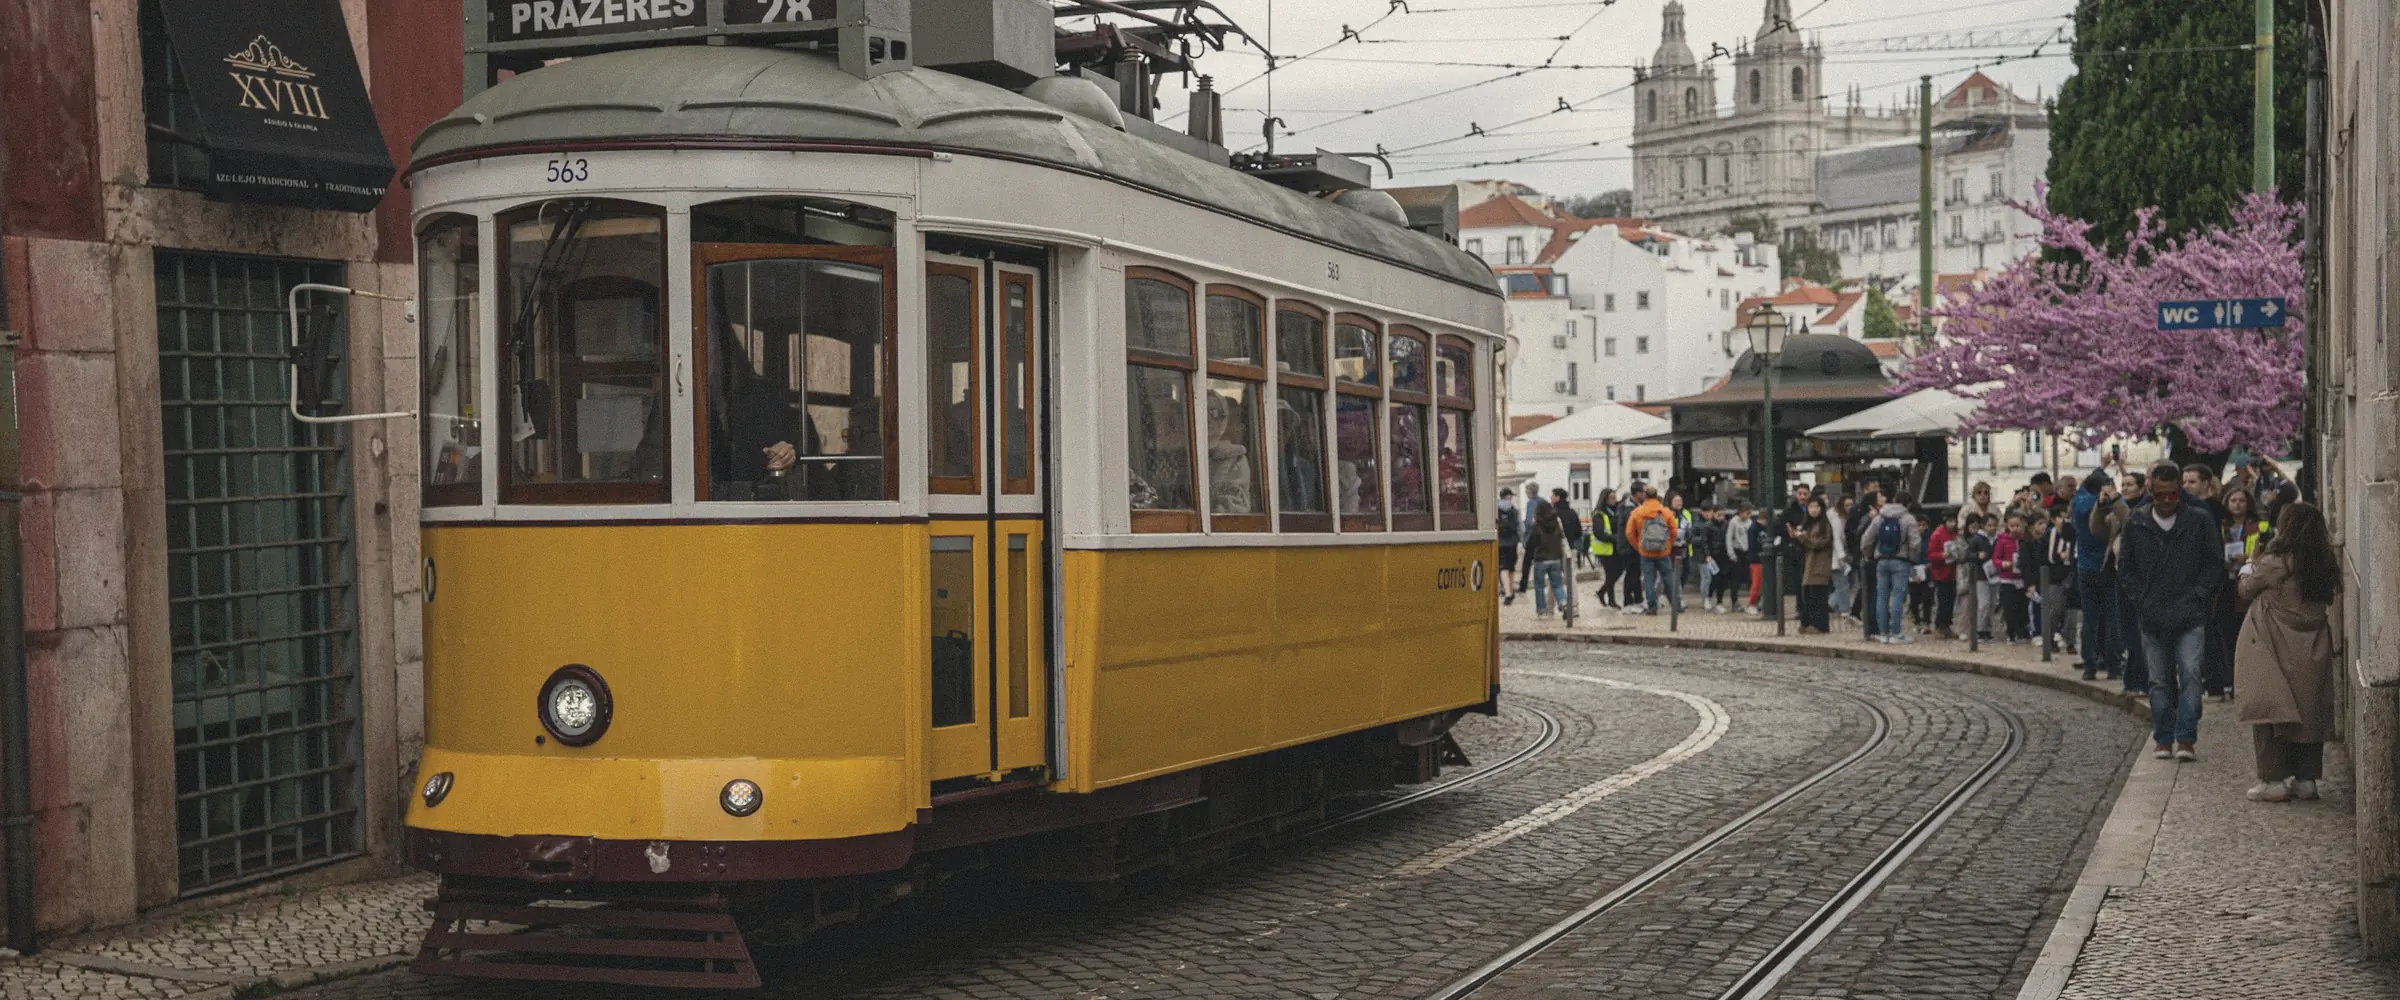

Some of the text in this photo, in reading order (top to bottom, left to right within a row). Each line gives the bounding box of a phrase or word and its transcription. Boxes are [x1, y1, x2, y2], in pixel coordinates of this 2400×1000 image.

[511, 0, 695, 34] PRAZERES
[229, 72, 330, 120] XVIII
[216, 173, 256, 184] AZULEJO
[257, 175, 309, 188] TRADICIONAL
[547, 158, 589, 183] 563
[1328, 261, 1339, 281] 563
[2162, 306, 2199, 324] WC
[1437, 558, 1466, 590] carris
